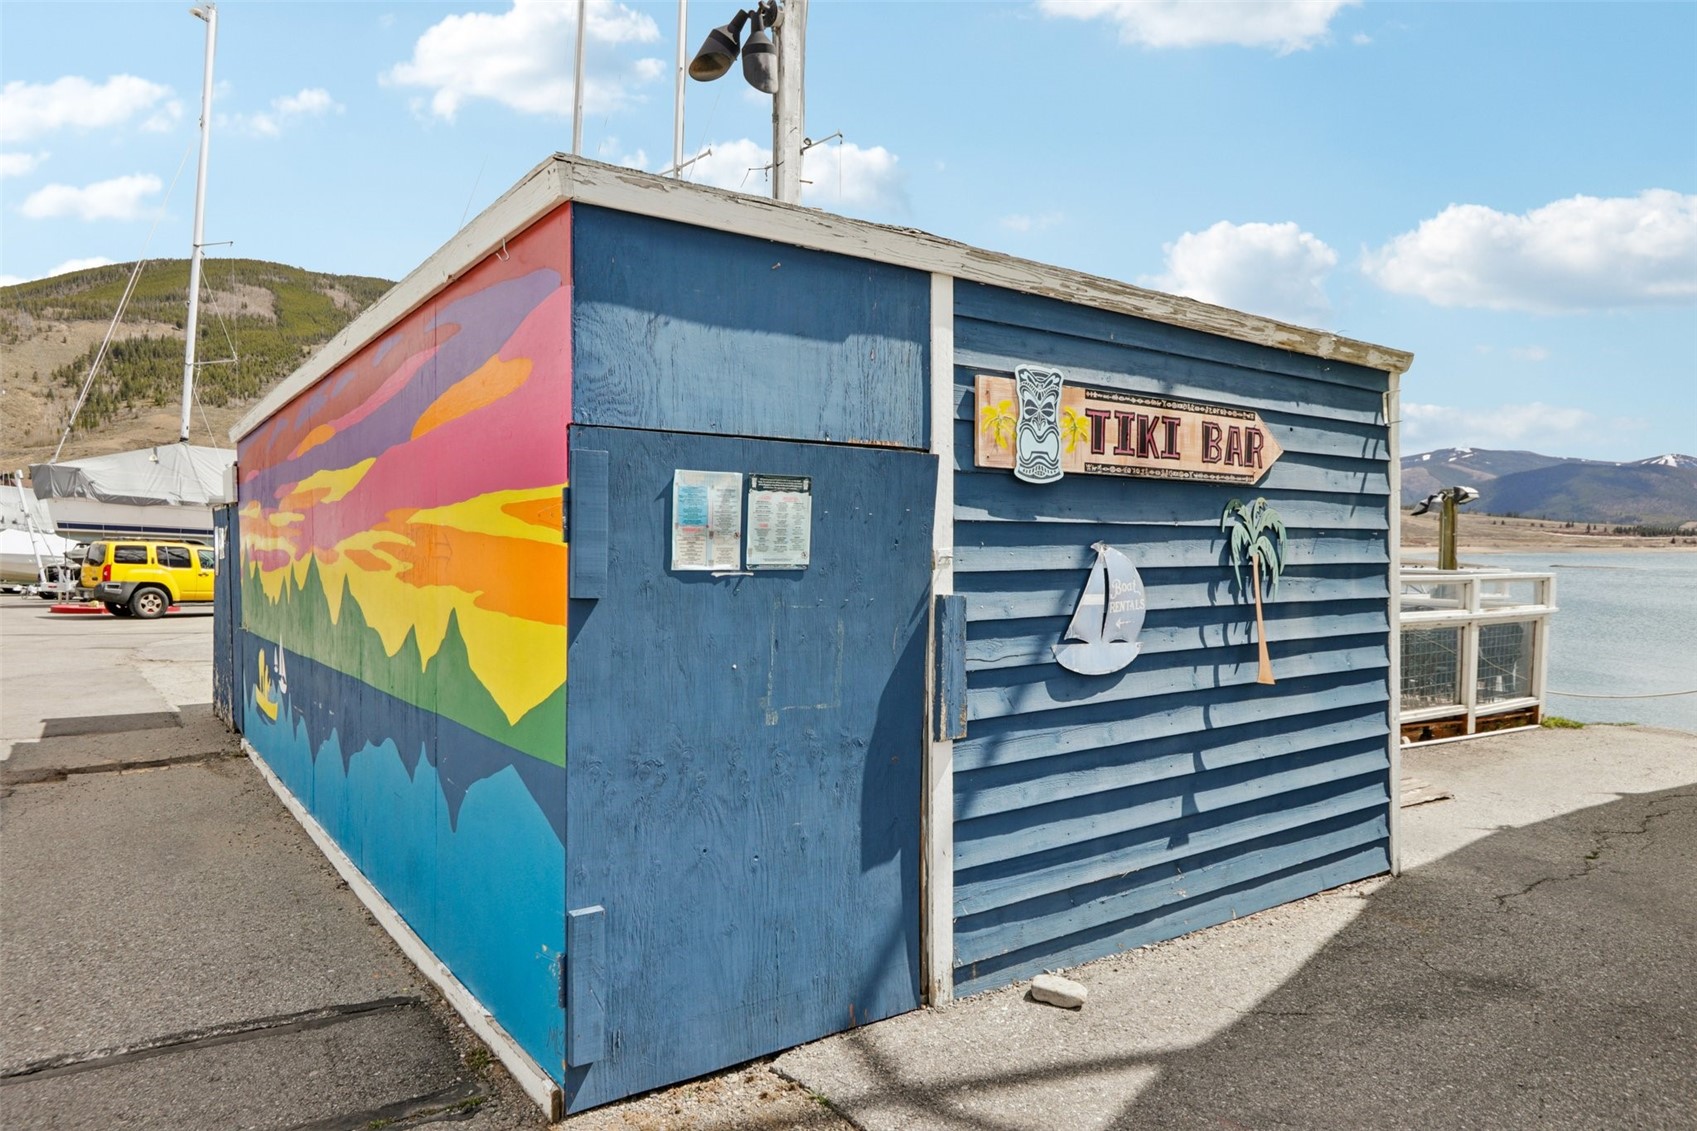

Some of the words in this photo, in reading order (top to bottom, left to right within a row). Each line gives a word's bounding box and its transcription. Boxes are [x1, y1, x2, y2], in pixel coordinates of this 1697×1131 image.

[1085, 408, 1181, 460] TIKI
[1202, 421, 1265, 468] BAR
[1110, 578, 1141, 599] Boat
[1109, 599, 1145, 613] RENTALS
